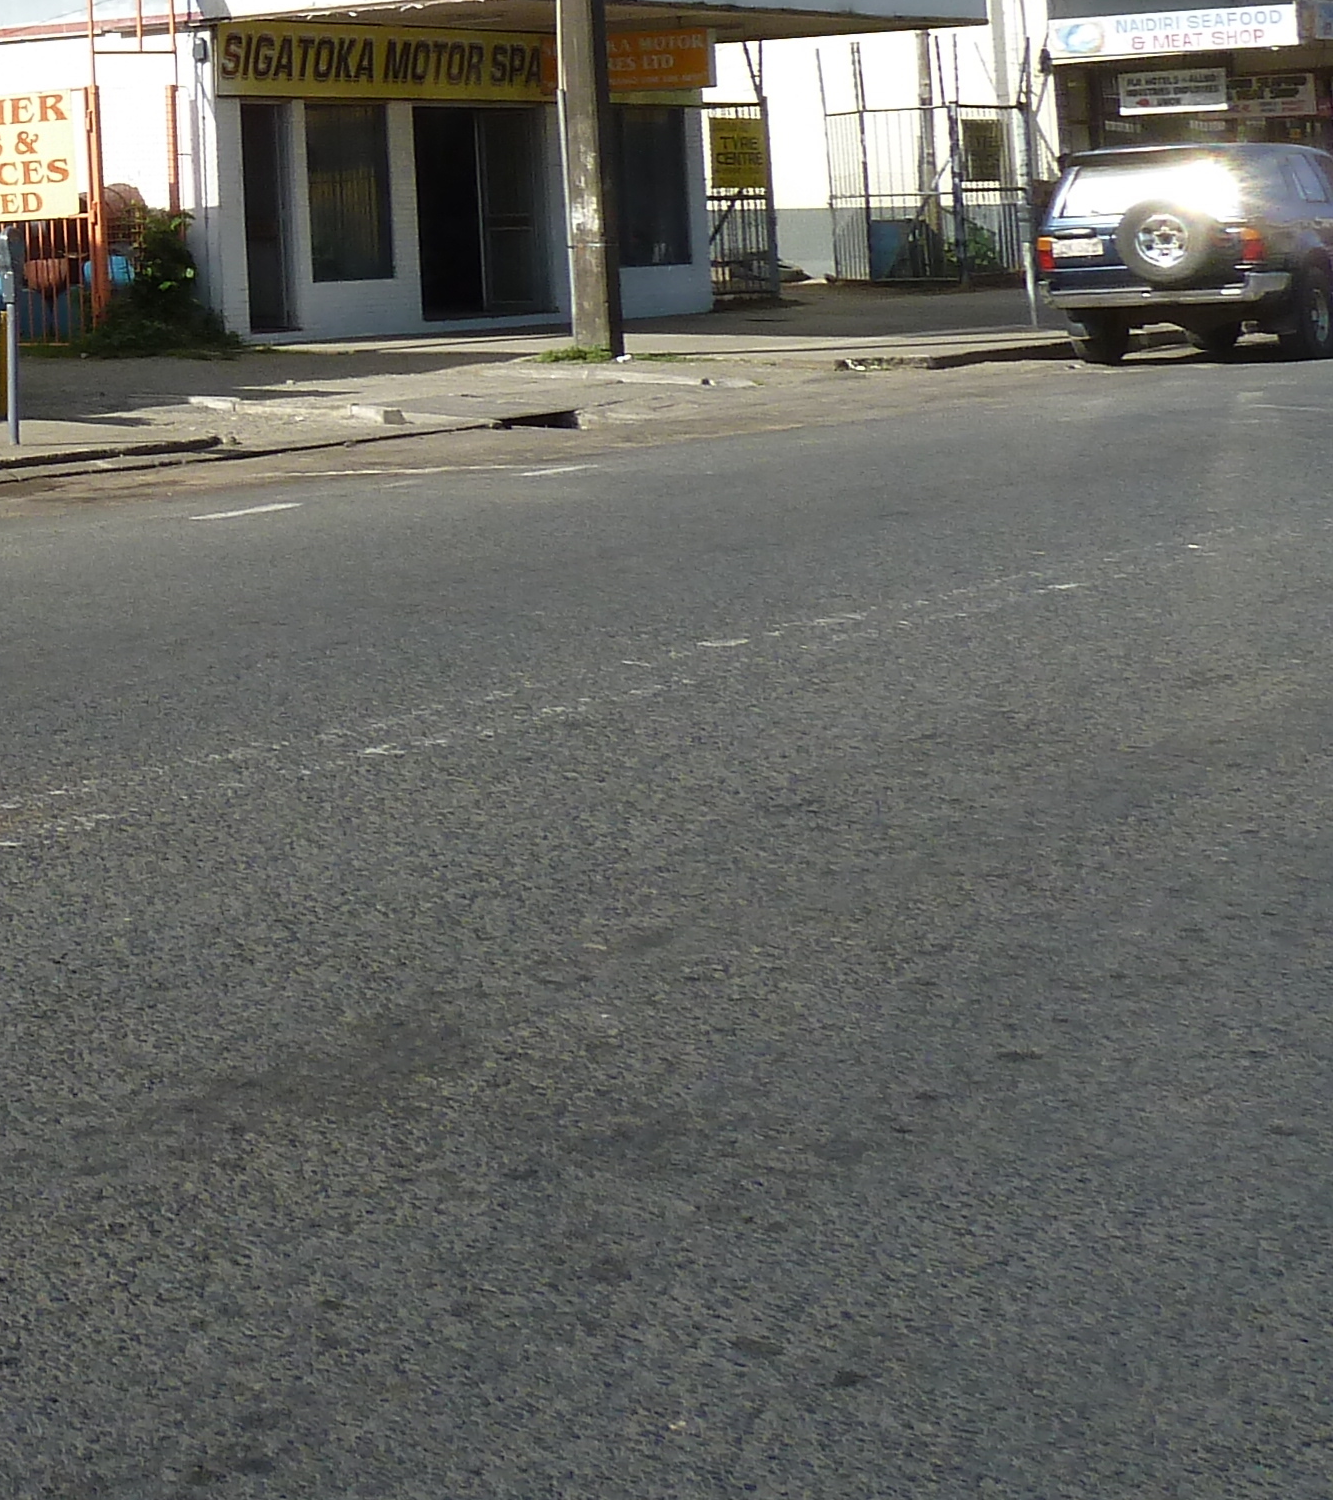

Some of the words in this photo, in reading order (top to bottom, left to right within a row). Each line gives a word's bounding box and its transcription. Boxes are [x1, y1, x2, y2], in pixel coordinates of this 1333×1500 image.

[1187, 10, 1282, 29] SEAFOOD
[1132, 36, 1145, 50] &
[1153, 33, 1202, 49] MEAT
[1212, 29, 1265, 46] SHOP
[221, 31, 374, 80] SIGATOKA
[384, 41, 484, 85] MOTOR
[490, 43, 541, 86] SPA
[643, 54, 674, 69] LTD
[14, 130, 39, 155] &
[720, 136, 757, 150] TYRE
[716, 152, 763, 165] CENTRE
